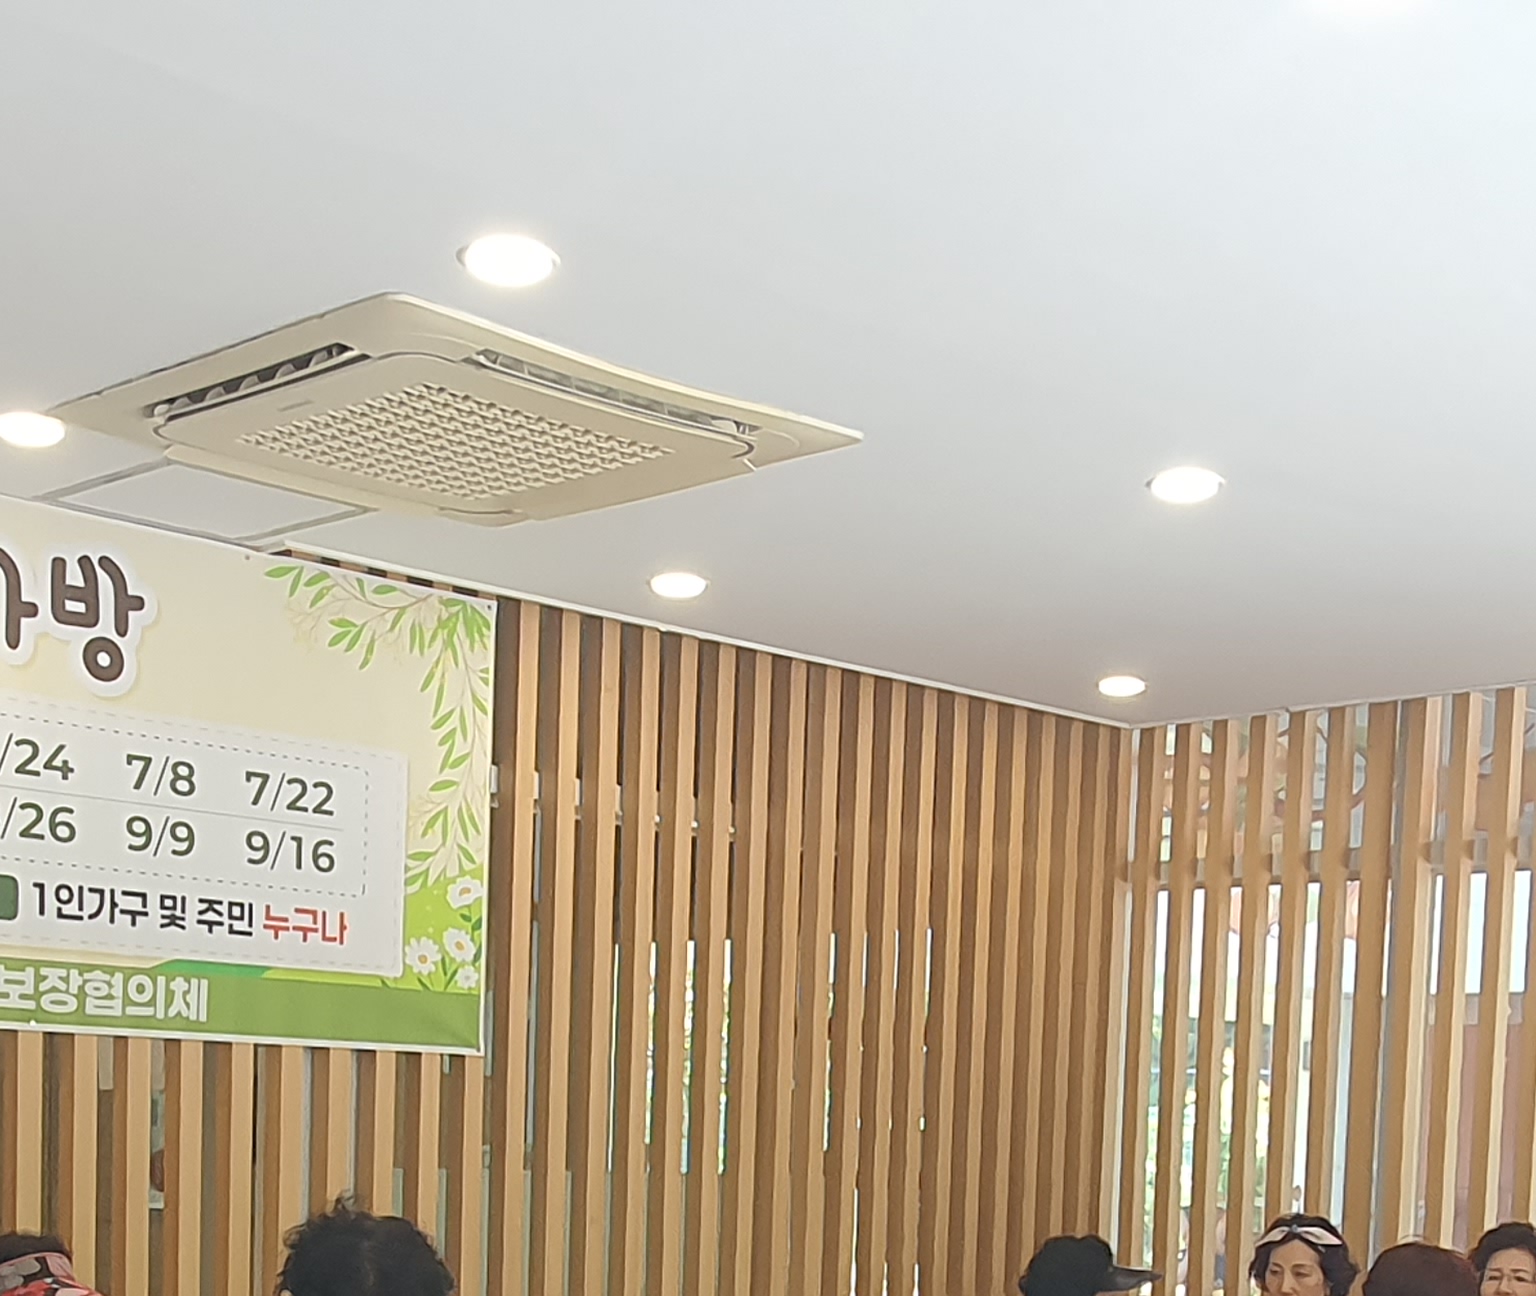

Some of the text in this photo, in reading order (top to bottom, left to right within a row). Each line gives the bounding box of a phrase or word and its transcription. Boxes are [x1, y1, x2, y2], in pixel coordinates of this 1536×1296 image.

[124, 753, 197, 797] 7/8
[243, 770, 336, 817] 7/22
[124, 815, 197, 857] 9/9
[244, 830, 337, 874] 9/16
[32, 881, 348, 946] 1인가구 및 주민 누구나
